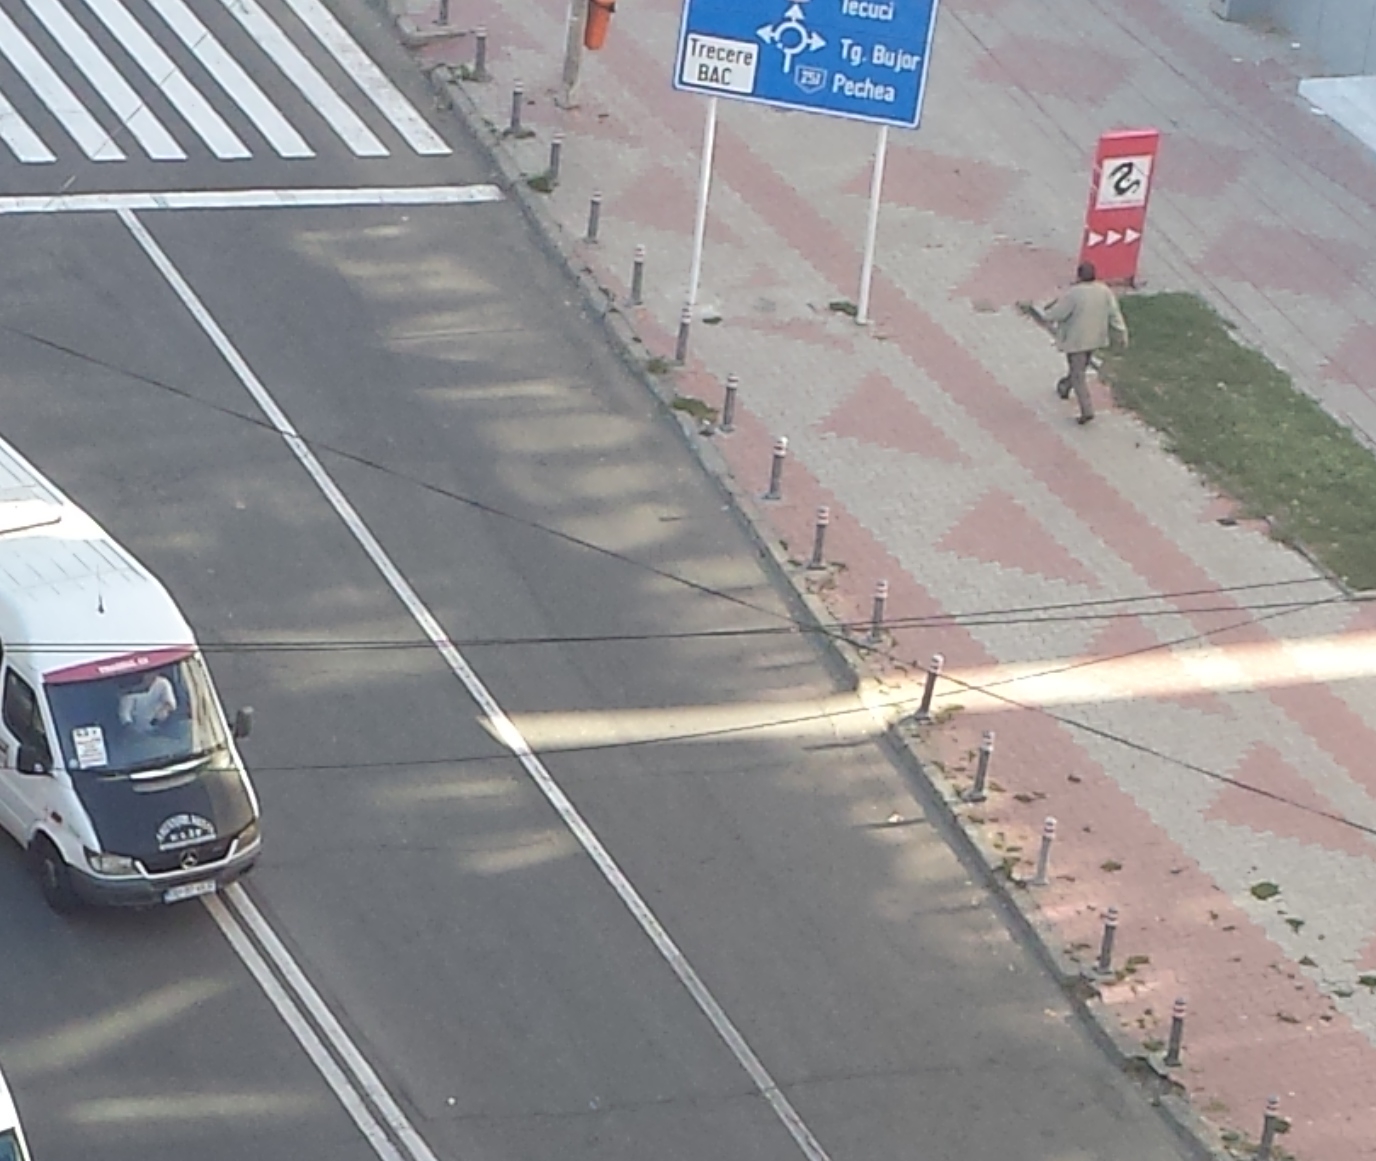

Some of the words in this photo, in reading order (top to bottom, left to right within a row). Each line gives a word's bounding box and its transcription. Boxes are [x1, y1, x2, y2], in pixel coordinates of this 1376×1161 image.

[690, 37, 753, 66] Trecere
[840, 38, 867, 67] Tg.
[872, 44, 921, 73] Bujor
[697, 64, 732, 86] BAC
[833, 73, 896, 103] Pechea
